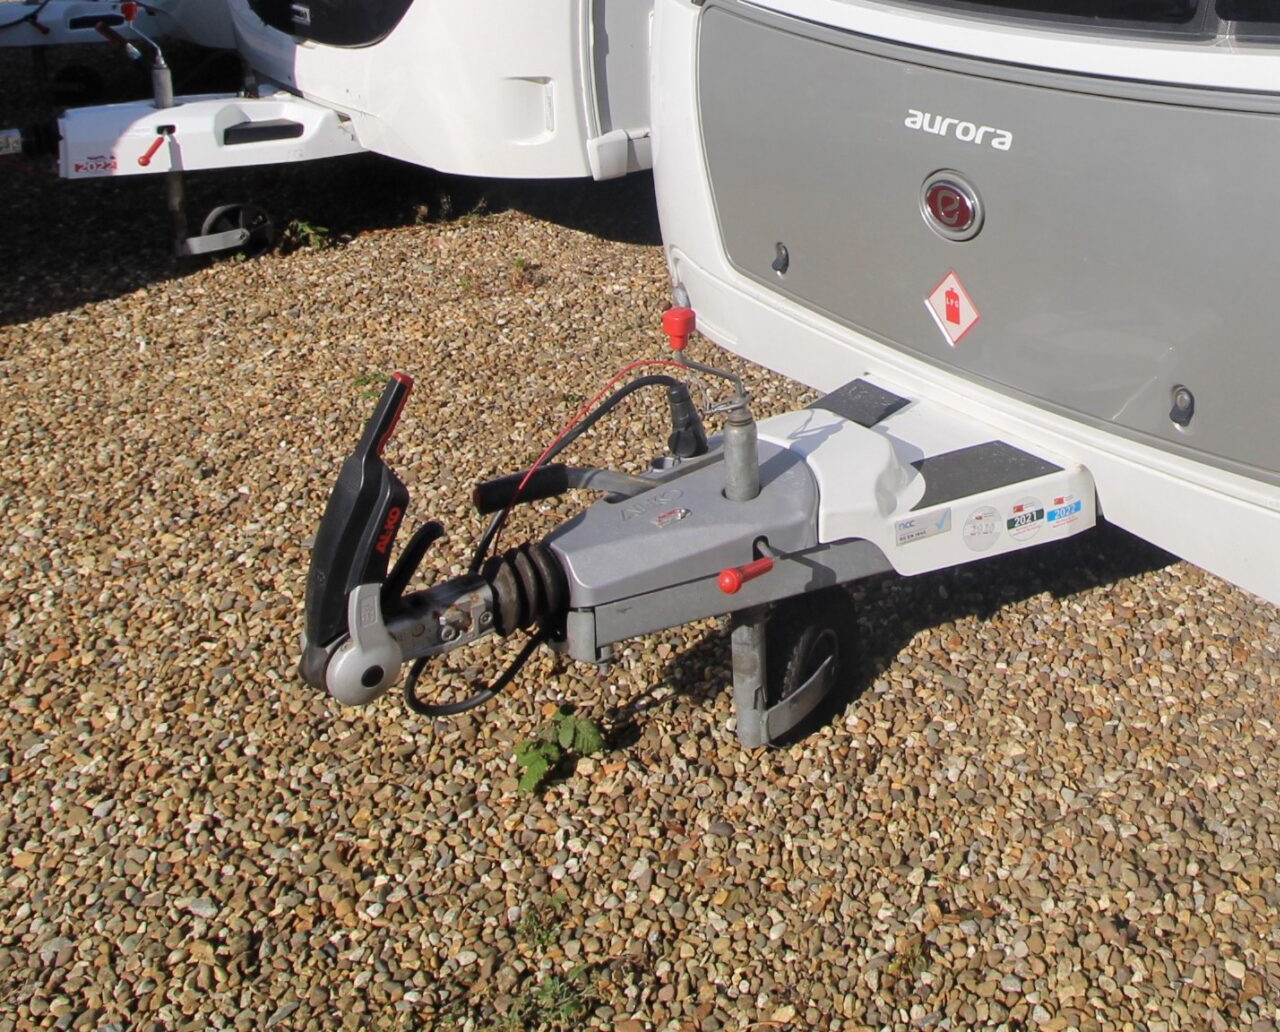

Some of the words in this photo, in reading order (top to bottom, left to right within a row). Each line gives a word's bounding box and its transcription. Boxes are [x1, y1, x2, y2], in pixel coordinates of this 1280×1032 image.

[904, 109, 1013, 151] aurora
[1014, 510, 1038, 528] 2021
[1054, 505, 1077, 519] 2022
